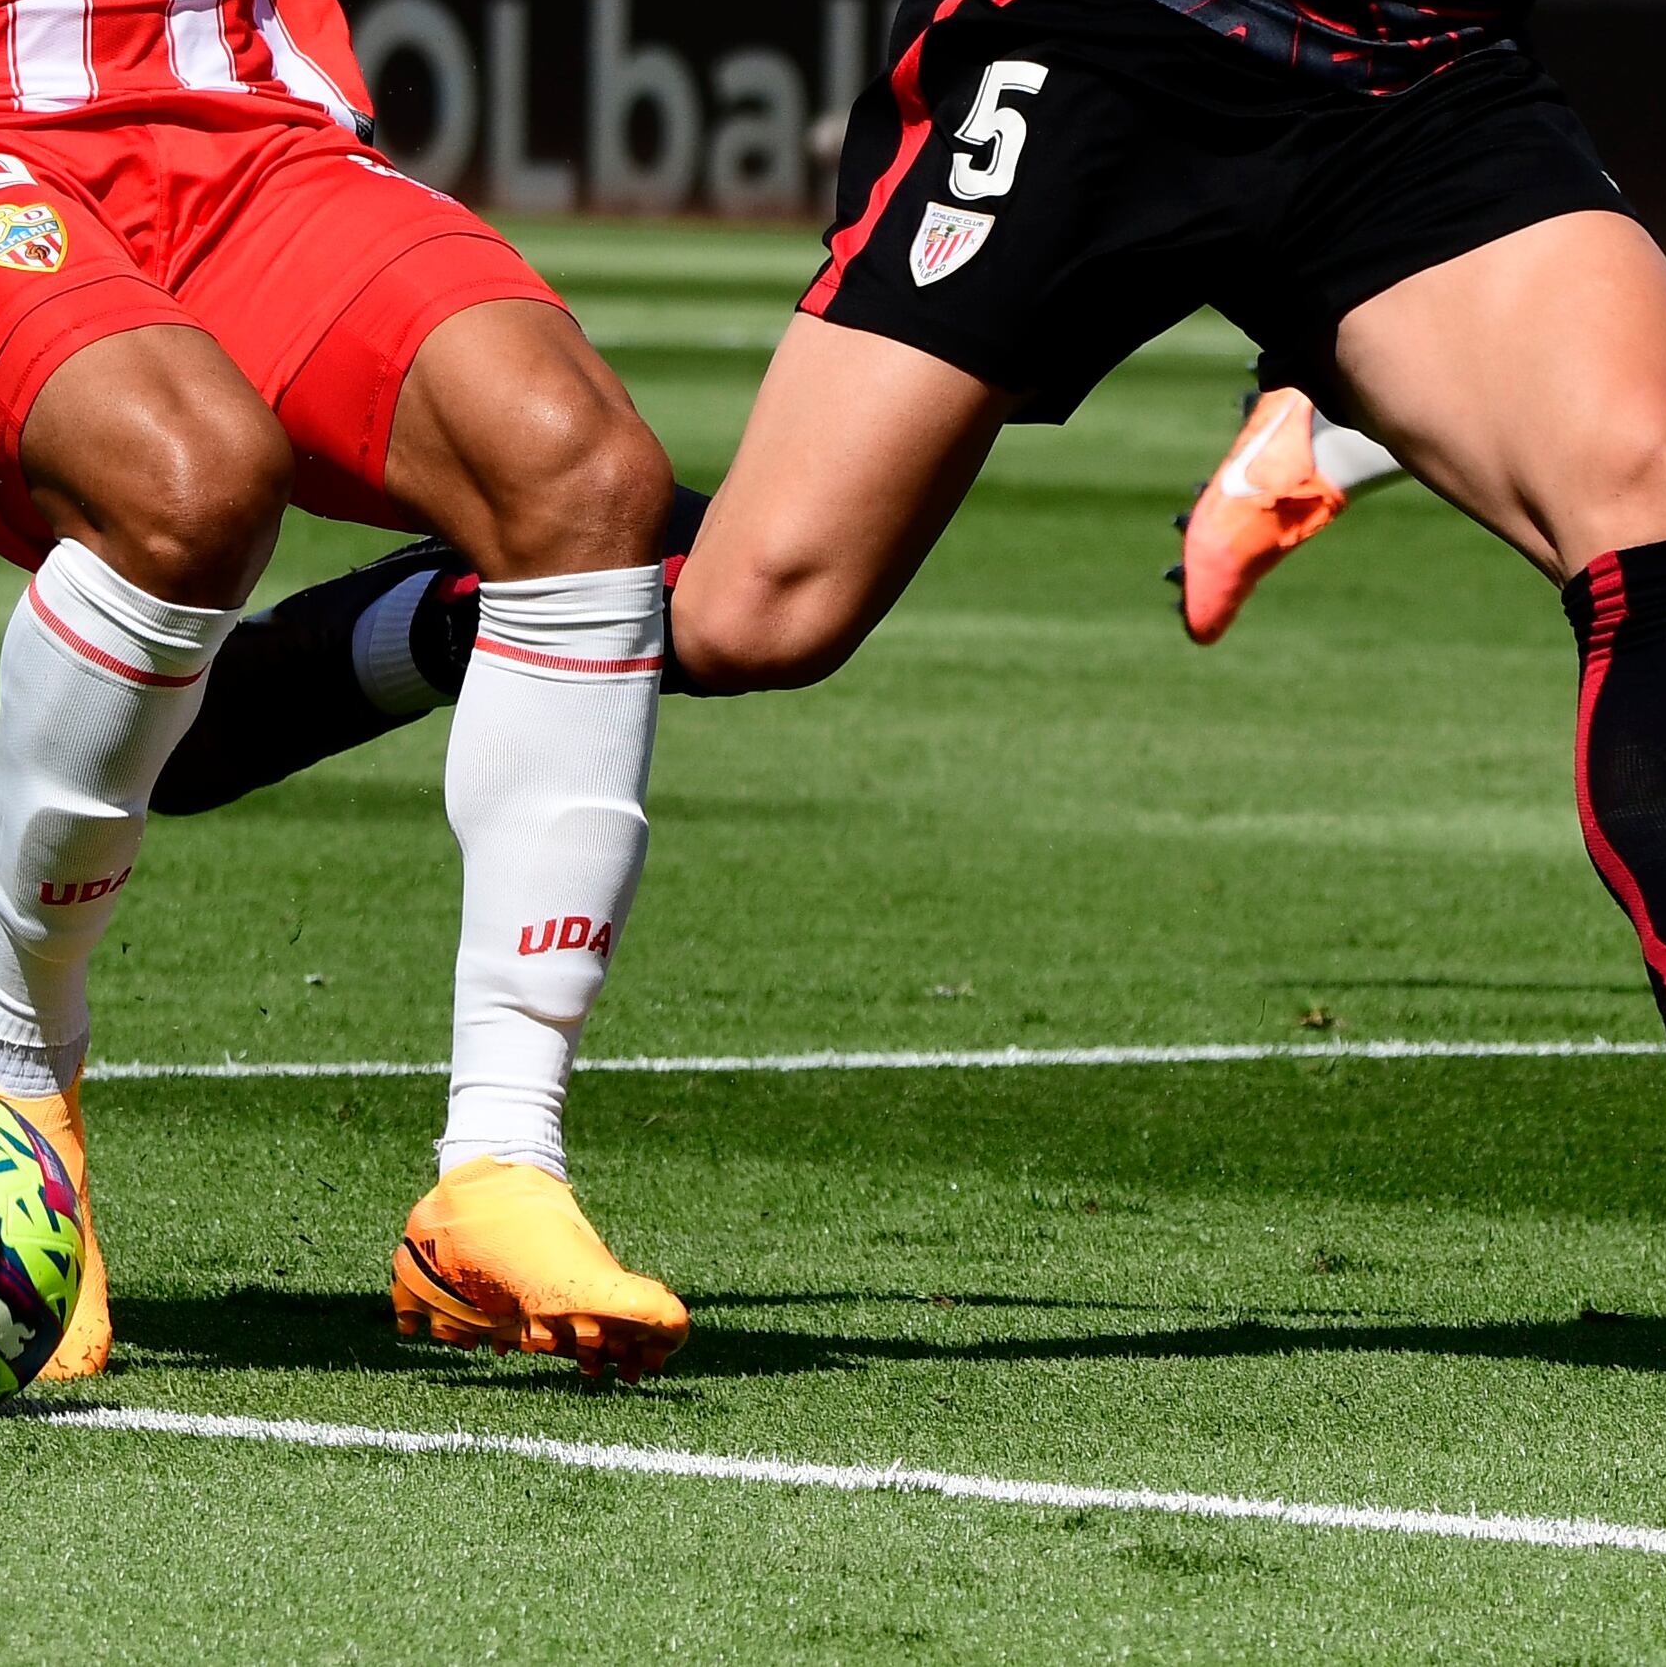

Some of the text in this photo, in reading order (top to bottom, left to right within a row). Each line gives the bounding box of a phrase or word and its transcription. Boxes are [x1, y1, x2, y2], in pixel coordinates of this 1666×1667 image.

[949, 61, 1049, 201] 5
[40, 866, 132, 906] UDA
[518, 916, 612, 958] UDA
